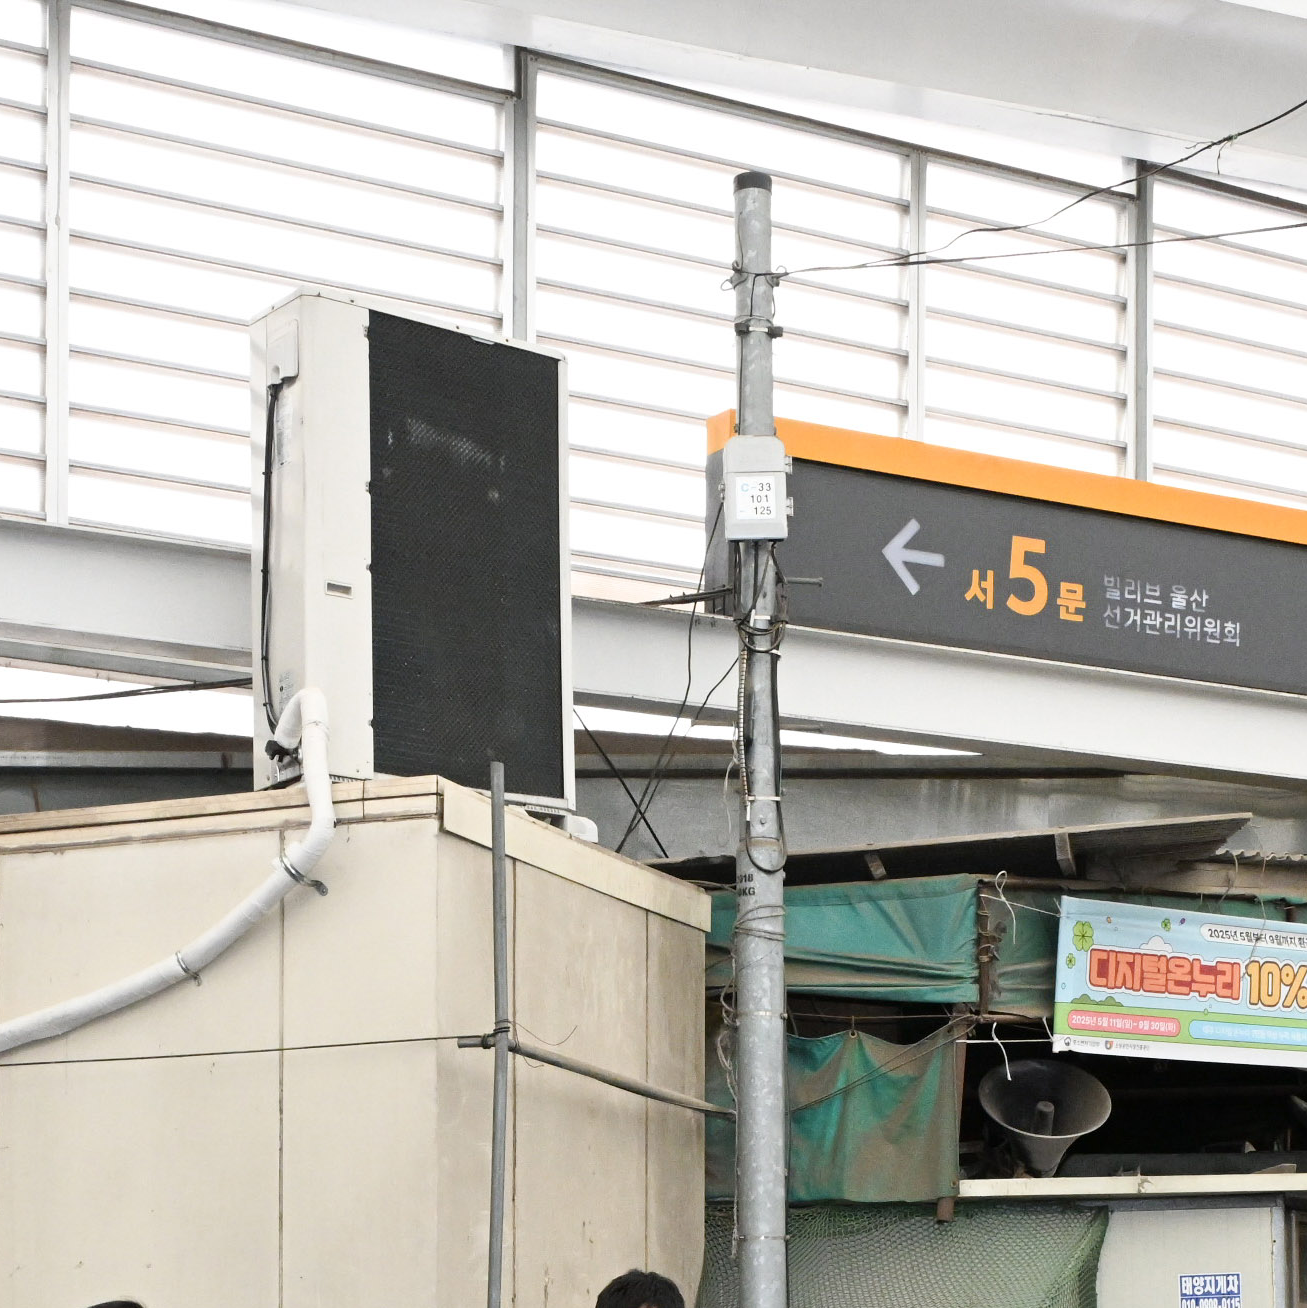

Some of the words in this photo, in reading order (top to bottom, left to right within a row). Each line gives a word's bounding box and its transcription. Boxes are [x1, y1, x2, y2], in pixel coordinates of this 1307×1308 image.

[750, 494, 769, 503] 101
[1103, 574, 1162, 605] 빌리브
[1170, 585, 1209, 613] 울산
[1102, 604, 1241, 647] 선거관리위원회
[1207, 928, 1239, 942] 2025년
[1269, 934, 1297, 948] 9월까지
[1088, 948, 1241, 1000] 디지털온누리
[1072, 1015, 1096, 1026] 2025년
[1097, 1017, 1108, 1027] 5월
[1182, 1276, 1238, 1295] 태양지게차
